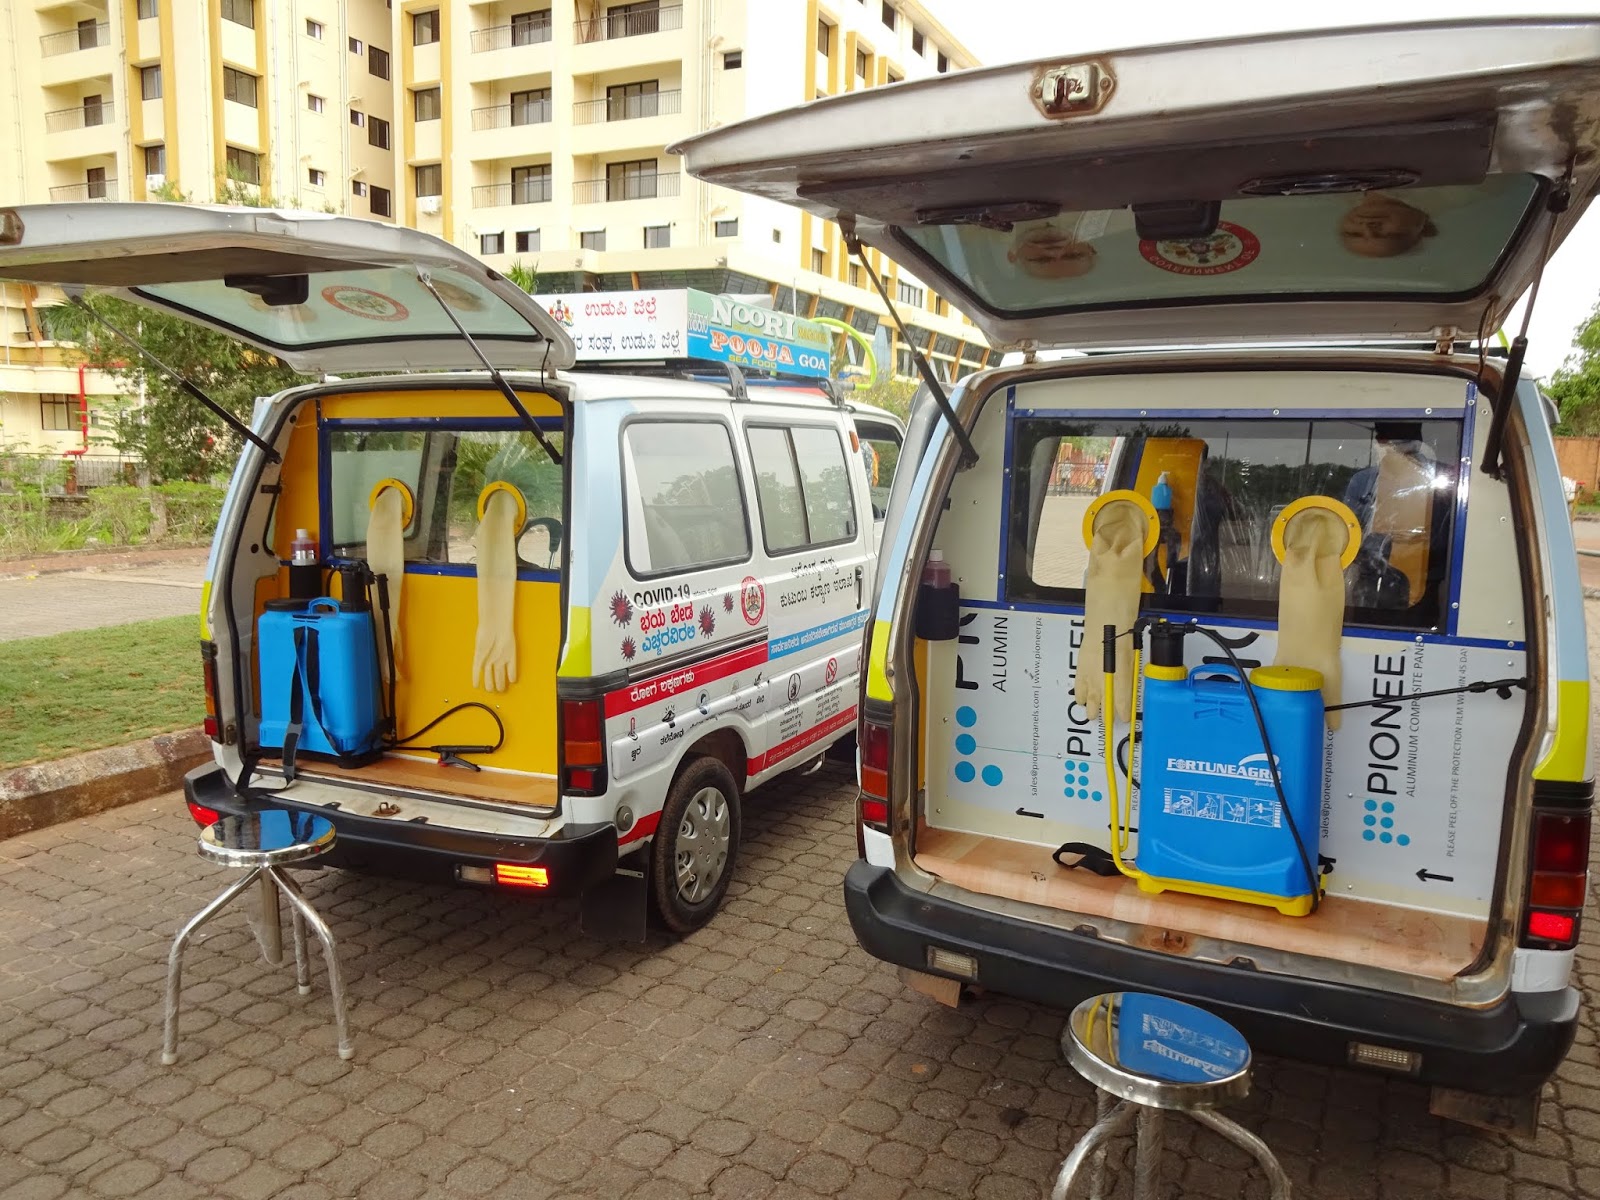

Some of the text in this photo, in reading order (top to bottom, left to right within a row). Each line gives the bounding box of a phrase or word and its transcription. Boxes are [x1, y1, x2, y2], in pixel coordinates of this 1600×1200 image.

[584, 296, 658, 323] ಉಡುಪಿ ಜಿಲ್ಲೆ
[710, 297, 796, 342] NOORI
[620, 331, 657, 350] ಉಡುಪಿ
[661, 329, 681, 355] ಜಿಲ್ಲೆ
[709, 329, 796, 366] POOJA
[798, 353, 827, 371] GOA
[728, 354, 777, 369] SEA FOOD
[633, 583, 691, 609] COVID-19
[640, 600, 694, 635] ಭಯ ಬೇಡ
[992, 613, 1008, 692] ALUMIN
[630, 681, 658, 703] ರೋಗ
[1366, 648, 1406, 796] PIONEE
[1455, 706, 1465, 726] FILM
[1031, 690, 1041, 797] sales@pioneerpanels.com
[1452, 726, 1465, 776] PROTECTION
[1405, 734, 1419, 798] ALUMINIUM
[1320, 726, 1335, 839] sales@pioneerpanels.co
[1450, 777, 1460, 793] THE
[1449, 793, 1459, 809] OFF
[1448, 810, 1458, 829] PEEL
[1446, 830, 1457, 858] PLEASE
